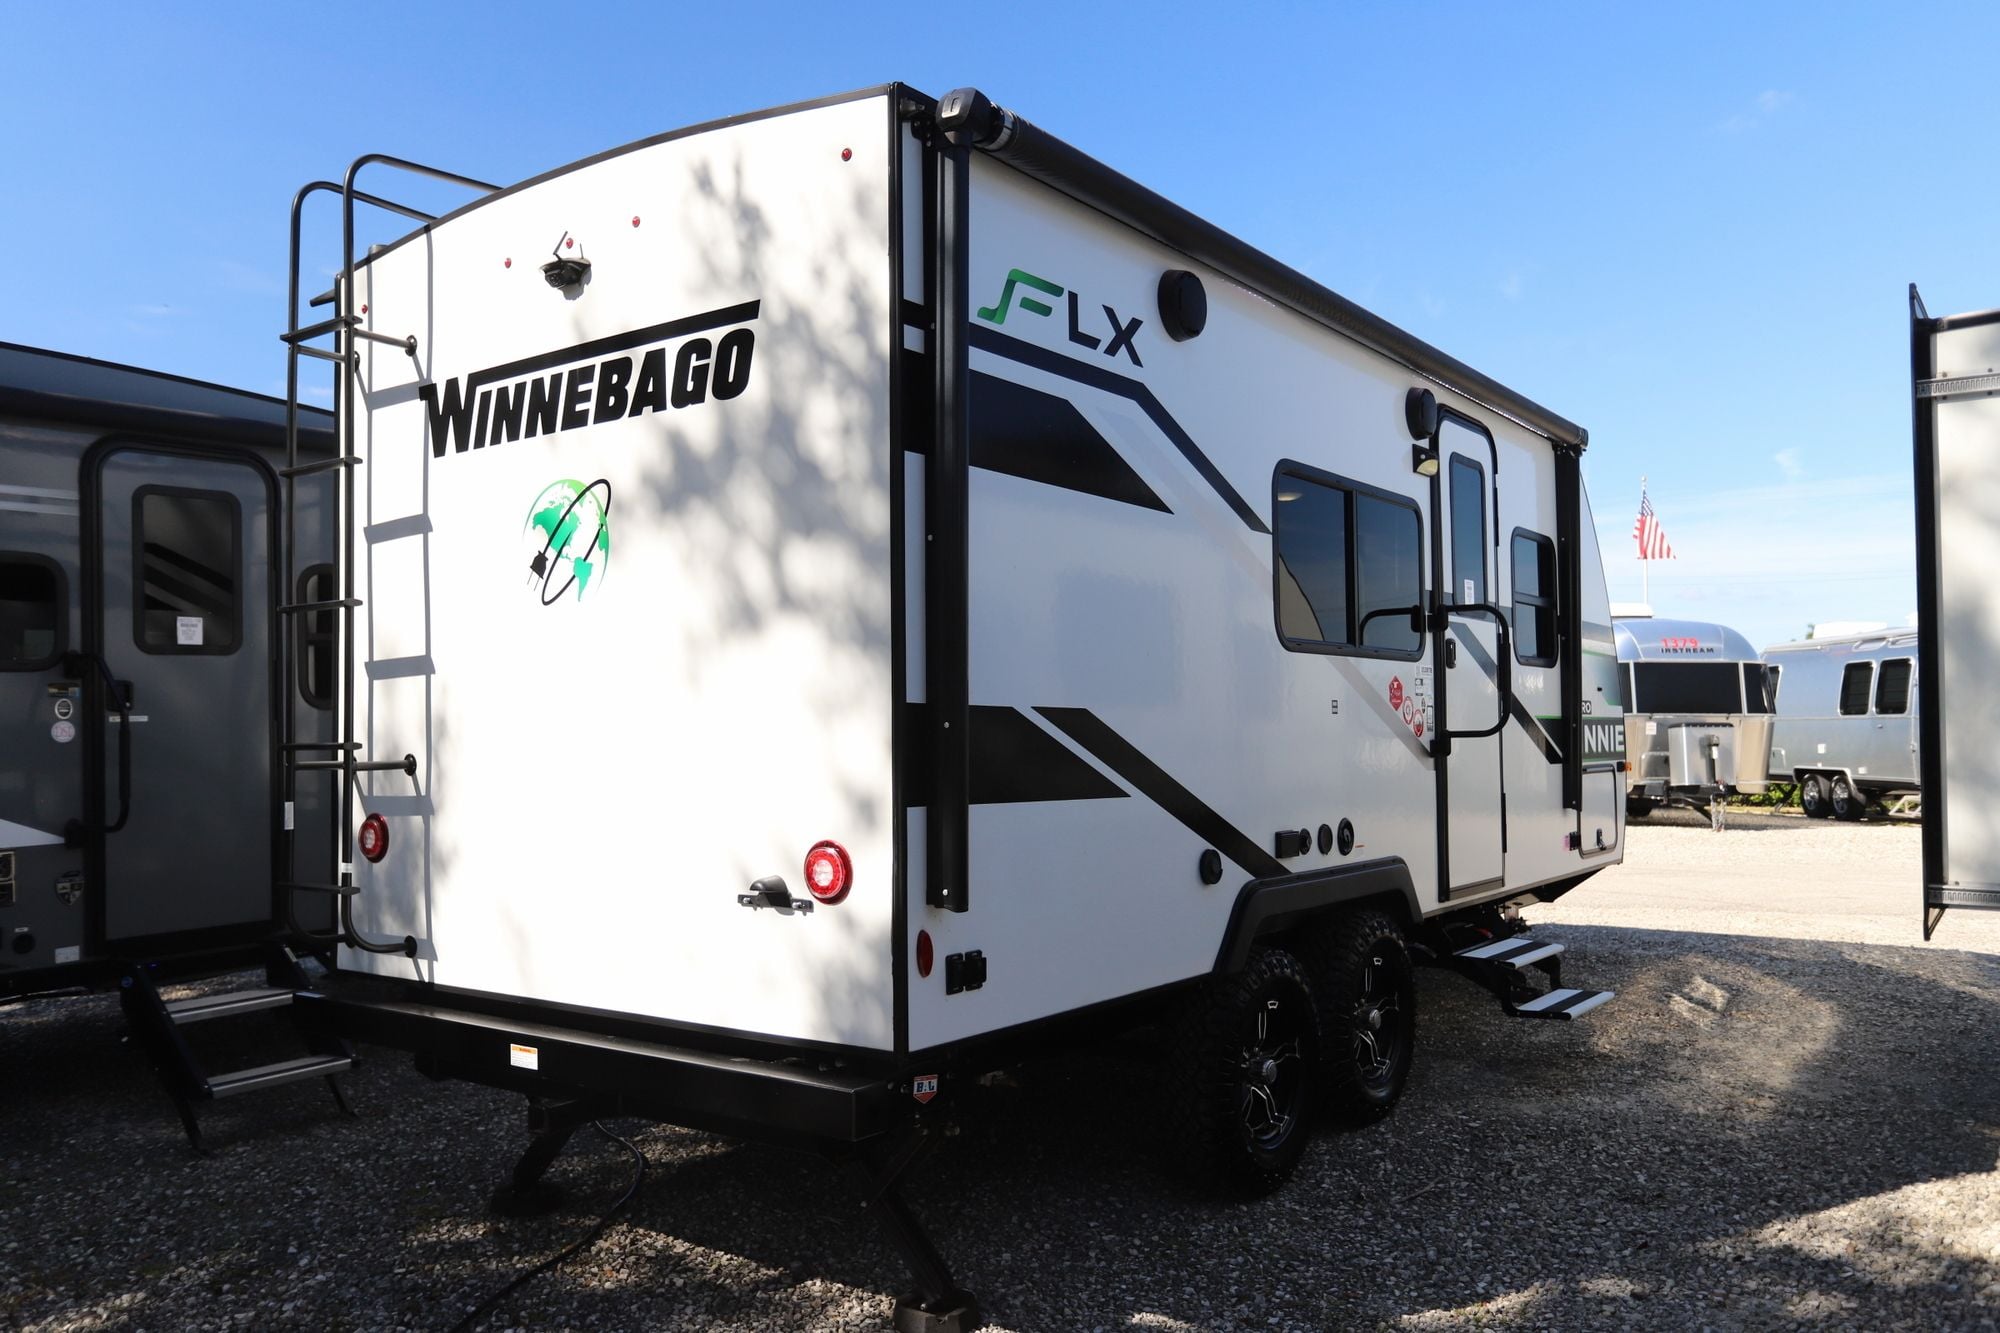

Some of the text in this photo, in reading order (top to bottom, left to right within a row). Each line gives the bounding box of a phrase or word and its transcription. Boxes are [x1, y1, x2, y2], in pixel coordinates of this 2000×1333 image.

[977, 268, 1144, 368] FLX
[419, 299, 761, 458] WINNEBAGO
[1662, 637, 1699, 648] 1379
